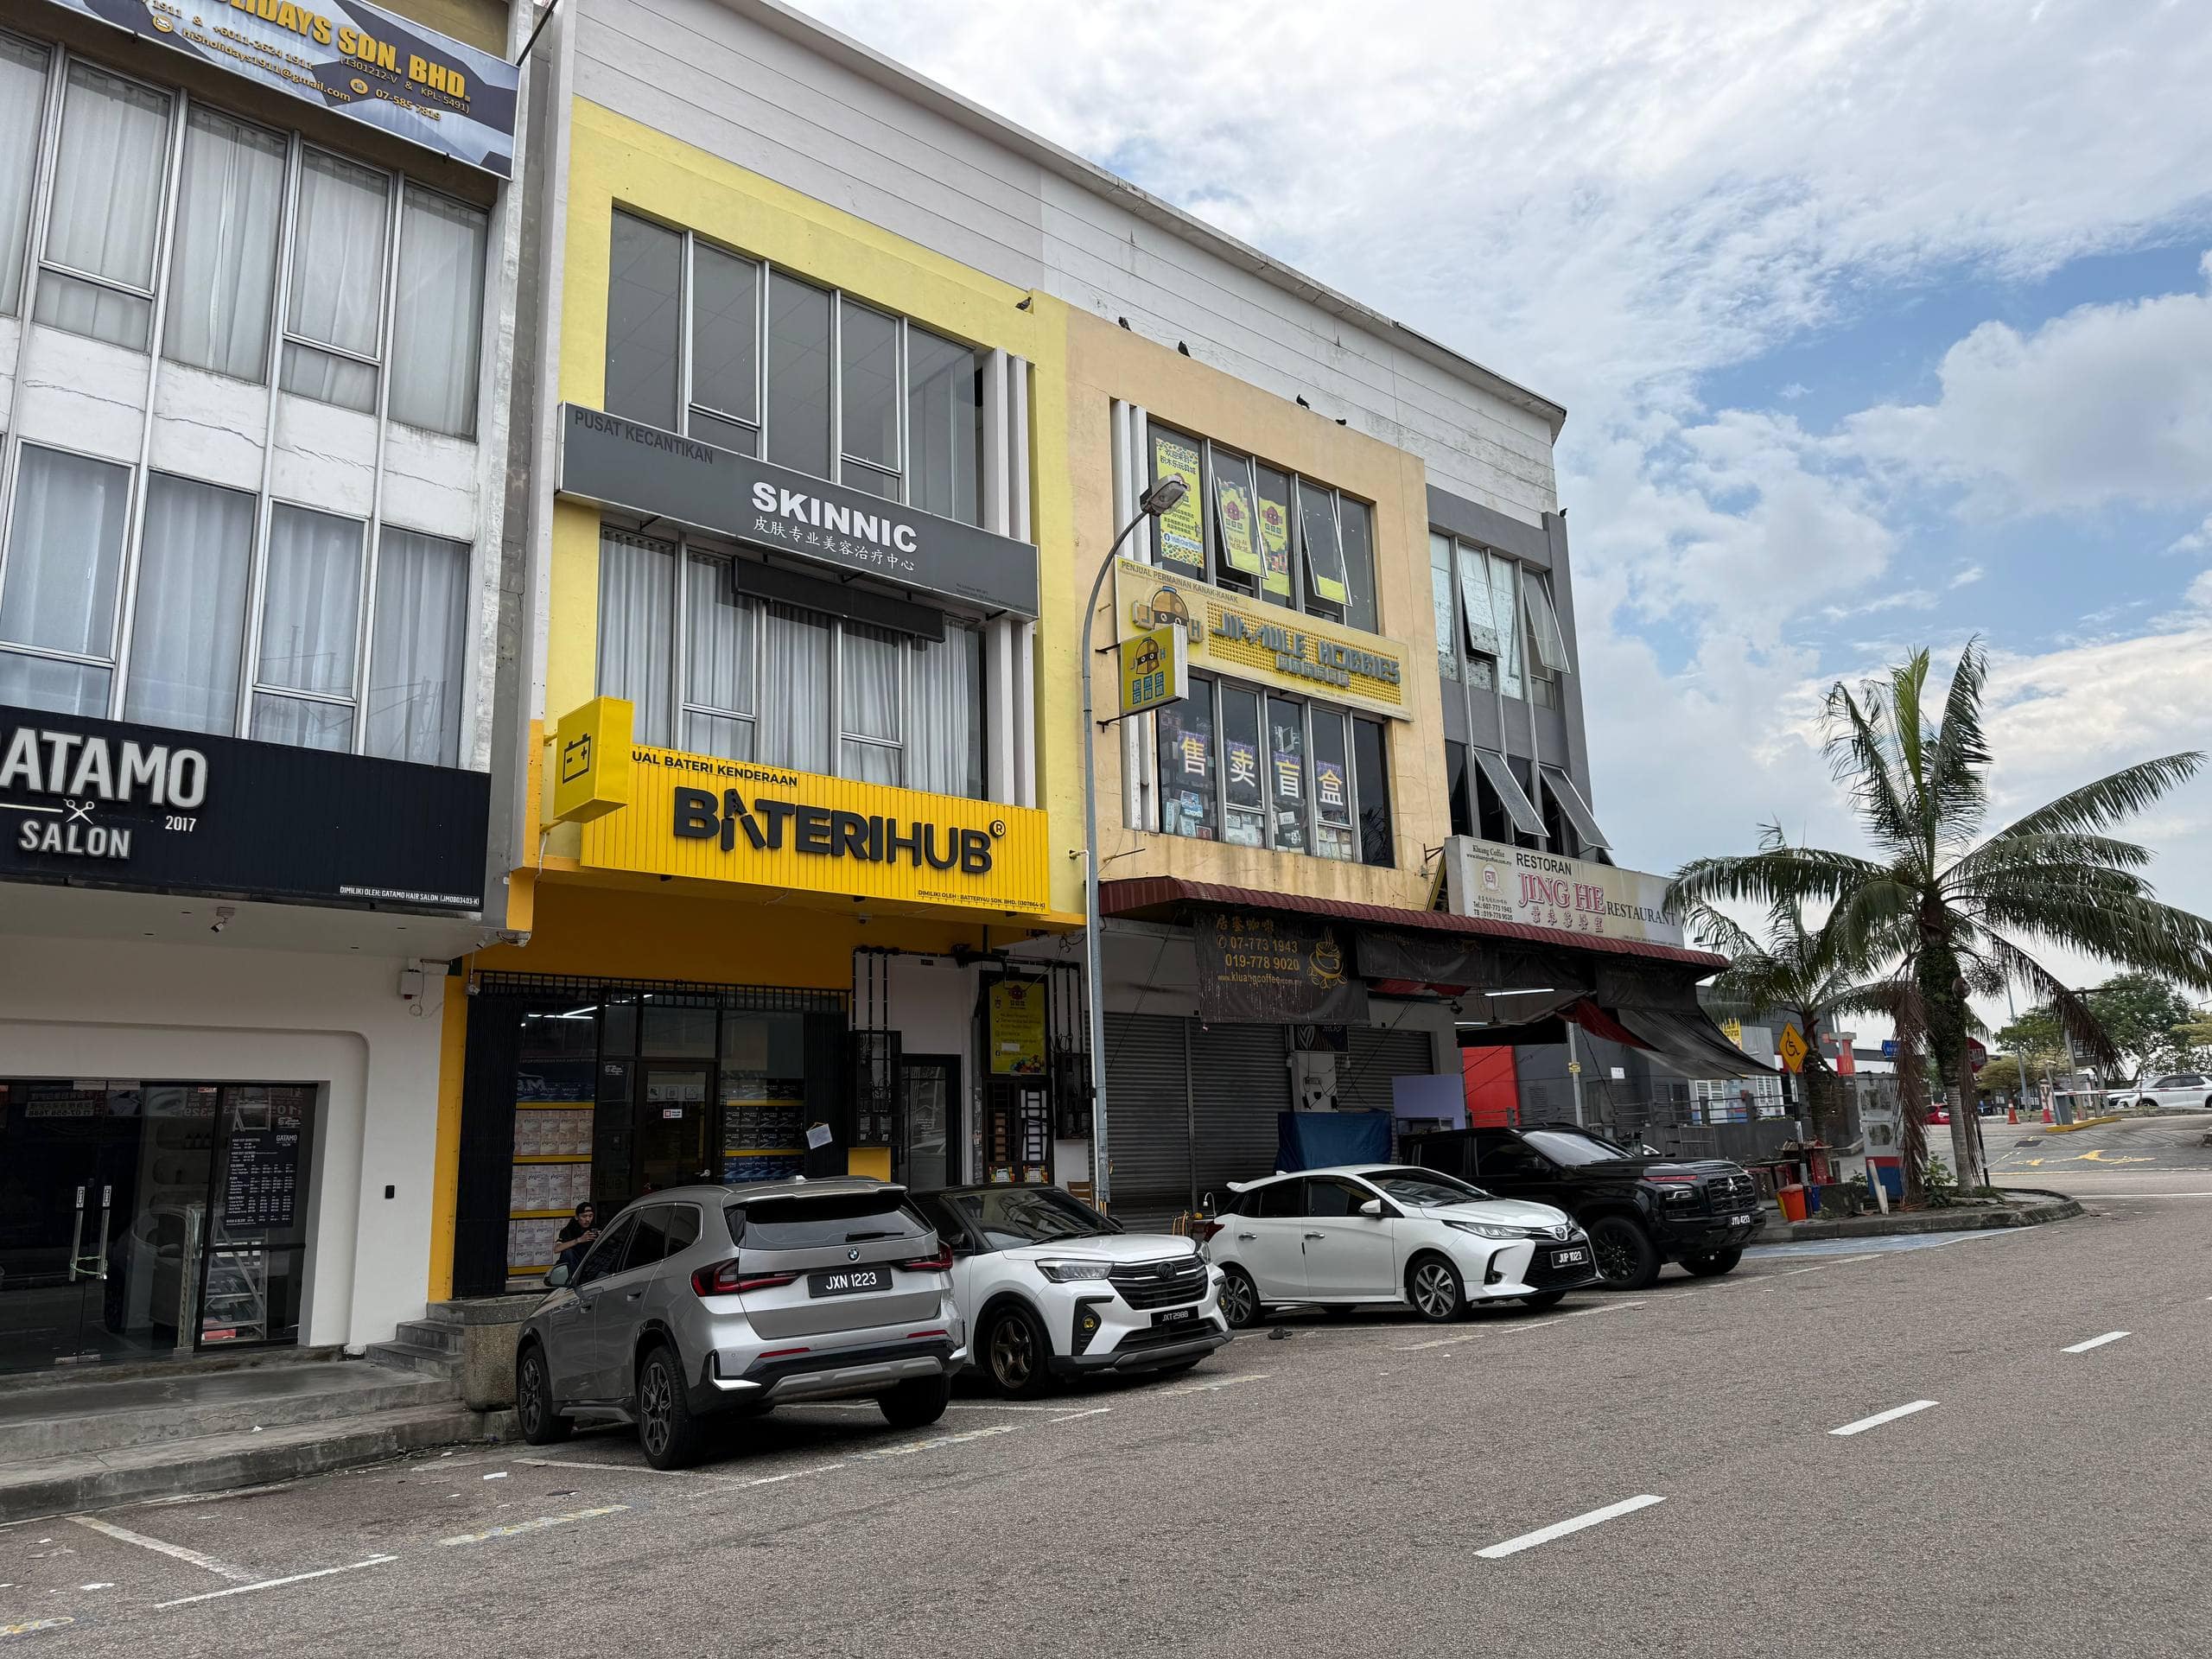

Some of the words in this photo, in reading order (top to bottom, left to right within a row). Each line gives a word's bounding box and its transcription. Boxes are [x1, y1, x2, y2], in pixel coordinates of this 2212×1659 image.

[192, 15, 203, 27] &
[213, 25, 283, 59] +6011-2624
[285, 53, 315, 72] 1911
[338, 27, 402, 75] SDN.
[409, 54, 471, 103] BHD.
[339, 54, 399, 85] (1301212-V
[404, 80, 414, 91] &
[420, 87, 442, 103] KPL:
[442, 96, 471, 115] 5491)
[375, 88, 413, 111] 07-585
[575, 410, 622, 436] PUSAT
[625, 424, 714, 465] KECANTIKAN
[752, 481, 918, 553] SKINNIC
[753, 516, 915, 571] 皮肤专业美容治疗中心
[1121, 561, 1153, 578] PENJUAL
[1153, 570, 1192, 589] PERMAINAN
[1192, 582, 1239, 603] KANAK-KANAK
[1317, 639, 1402, 684] HOBBIES
[0, 726, 209, 810] ATAMO
[632, 750, 660, 766] UAL
[664, 756, 714, 773] BATERI
[716, 764, 798, 787] KENDERAAN
[1180, 736, 1344, 807] 售卖盲盒
[17, 817, 132, 860] SALON
[164, 815, 197, 832] 2017
[673, 785, 994, 874] BATERIHUB
[1516, 852, 1573, 876] RESTORAN
[340, 886, 364, 895] DIMILIKI
[364, 887, 382, 897] OLEH:
[381, 890, 405, 899] GATAMO
[405, 892, 420, 900] HAIR
[420, 893, 439, 902] SALON
[1517, 871, 1571, 909] JING
[1573, 881, 1607, 915] HE
[1605, 900, 1676, 926] RESTAURANT
[1224, 953, 1271, 969] 019-778
[1273, 957, 1300, 971] 9020
[1230, 936, 1269, 951] 07-773
[1272, 939, 1299, 954] 1943
[825, 1274, 849, 1290] JXN
[850, 1272, 877, 1287] 1223
